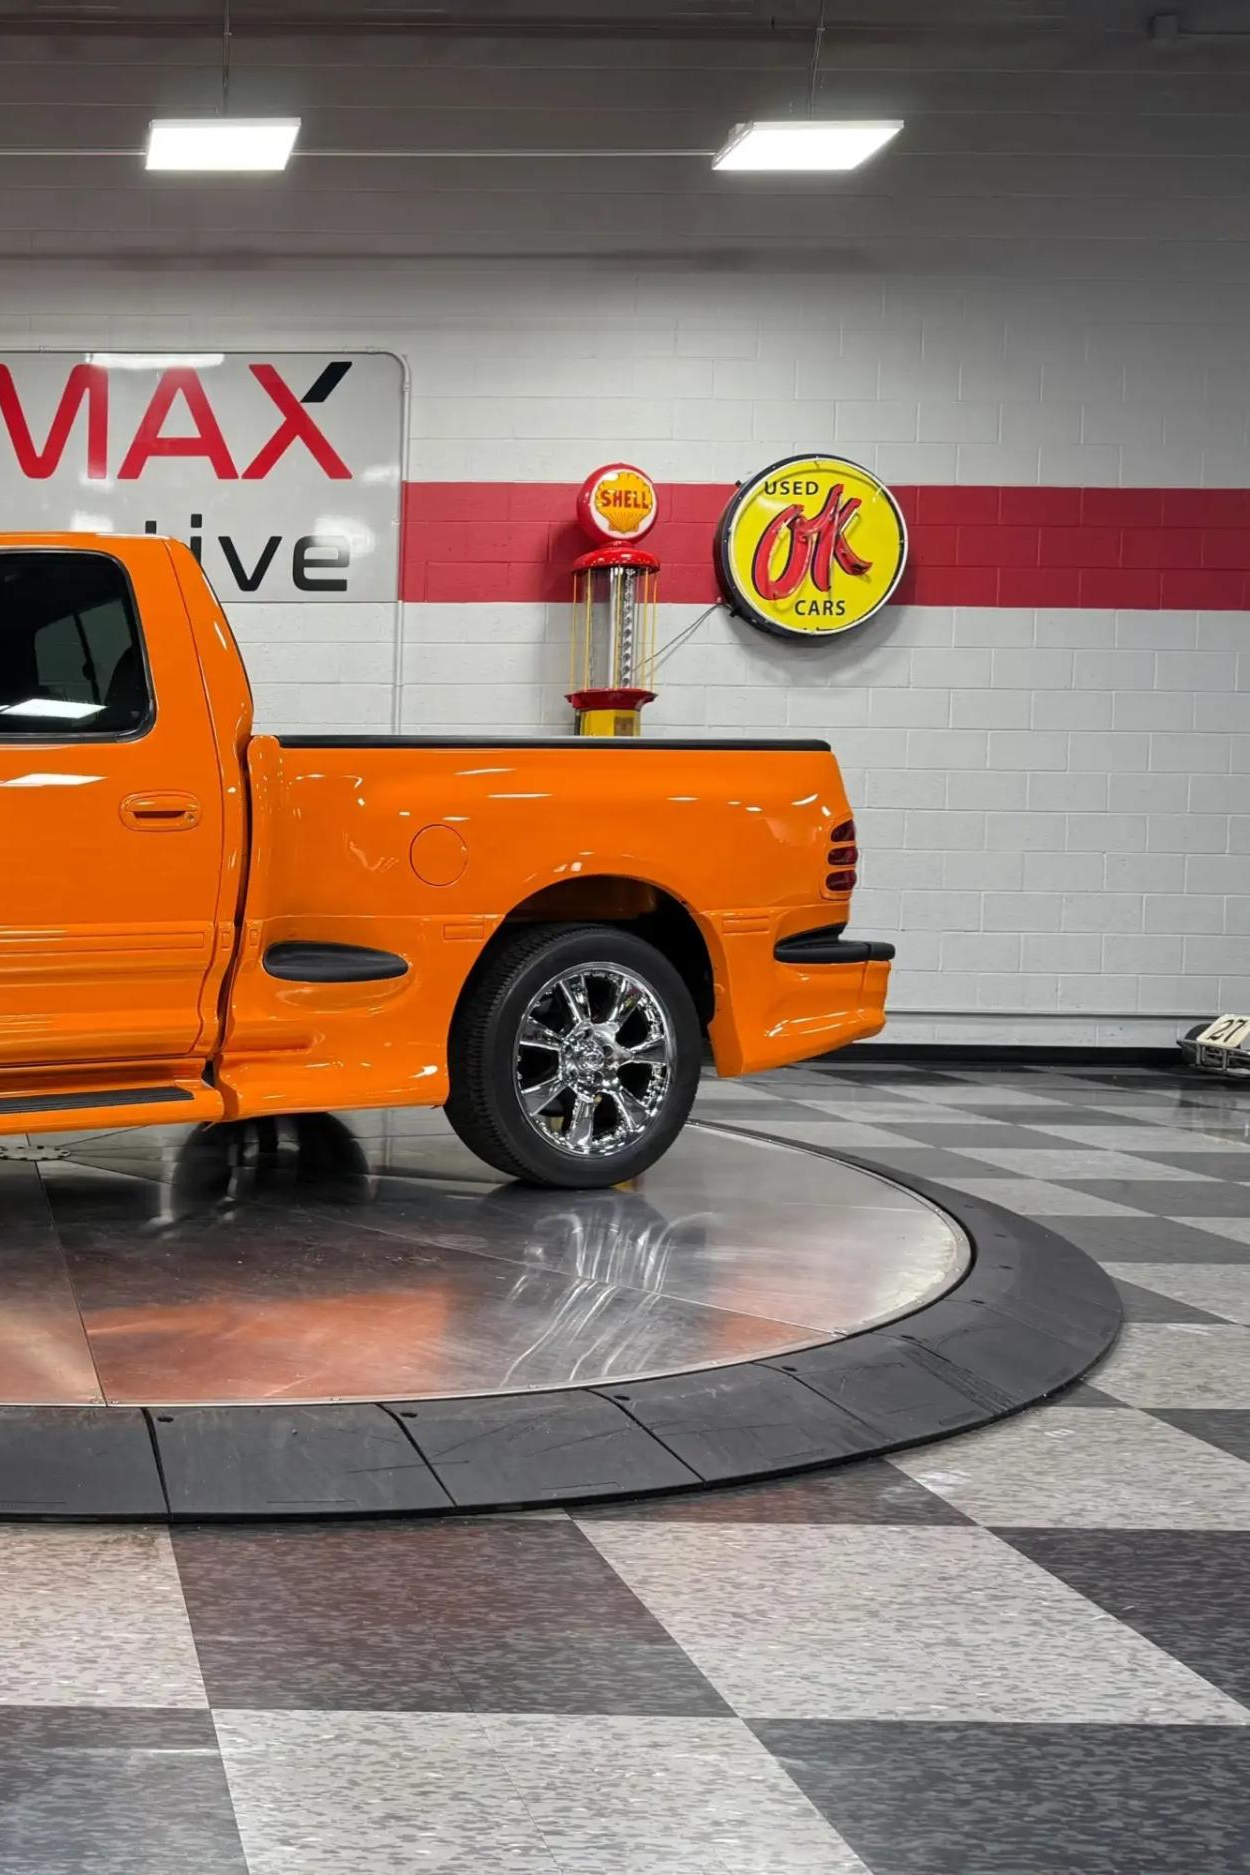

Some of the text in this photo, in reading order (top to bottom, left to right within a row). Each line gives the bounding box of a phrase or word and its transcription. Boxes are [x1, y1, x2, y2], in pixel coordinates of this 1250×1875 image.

[764, 481, 819, 496] USED
[600, 489, 649, 511] SHELL
[752, 484, 874, 601] OK
[794, 600, 846, 616] CARS
[1207, 1019, 1248, 1042] 27
